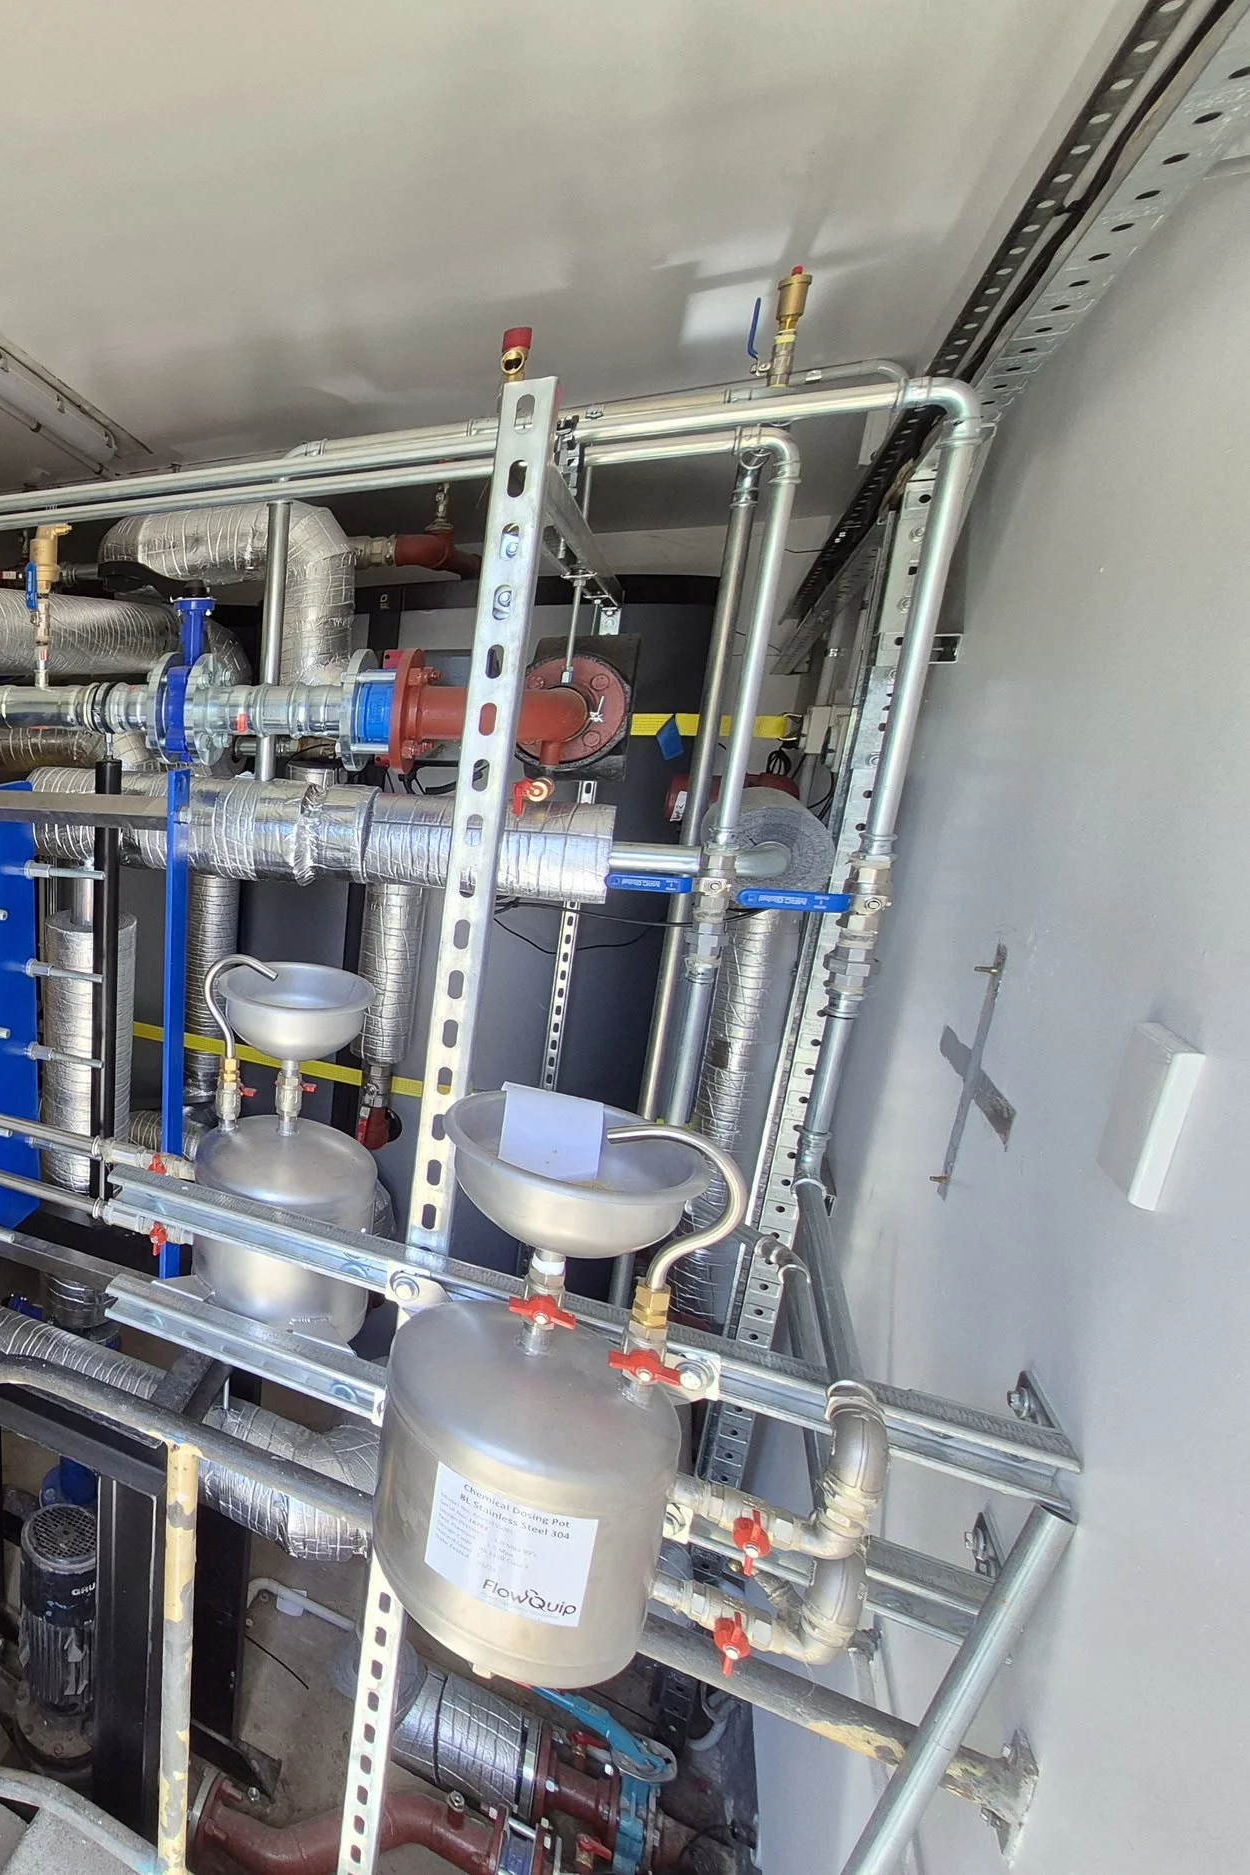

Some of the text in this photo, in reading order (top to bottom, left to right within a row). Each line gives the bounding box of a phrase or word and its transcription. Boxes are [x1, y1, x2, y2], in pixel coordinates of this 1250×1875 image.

[758, 893, 808, 906] MRC Global
[459, 1493, 471, 1505] 8L
[472, 1500, 518, 1527] Stainless
[520, 1521, 548, 1536] Steel
[550, 1529, 570, 1540] 304
[463, 1483, 510, 1511] Chemical
[512, 1506, 549, 1526] Dosing
[551, 1518, 570, 1529] Pot
[482, 1578, 577, 1617] FlowQuip
